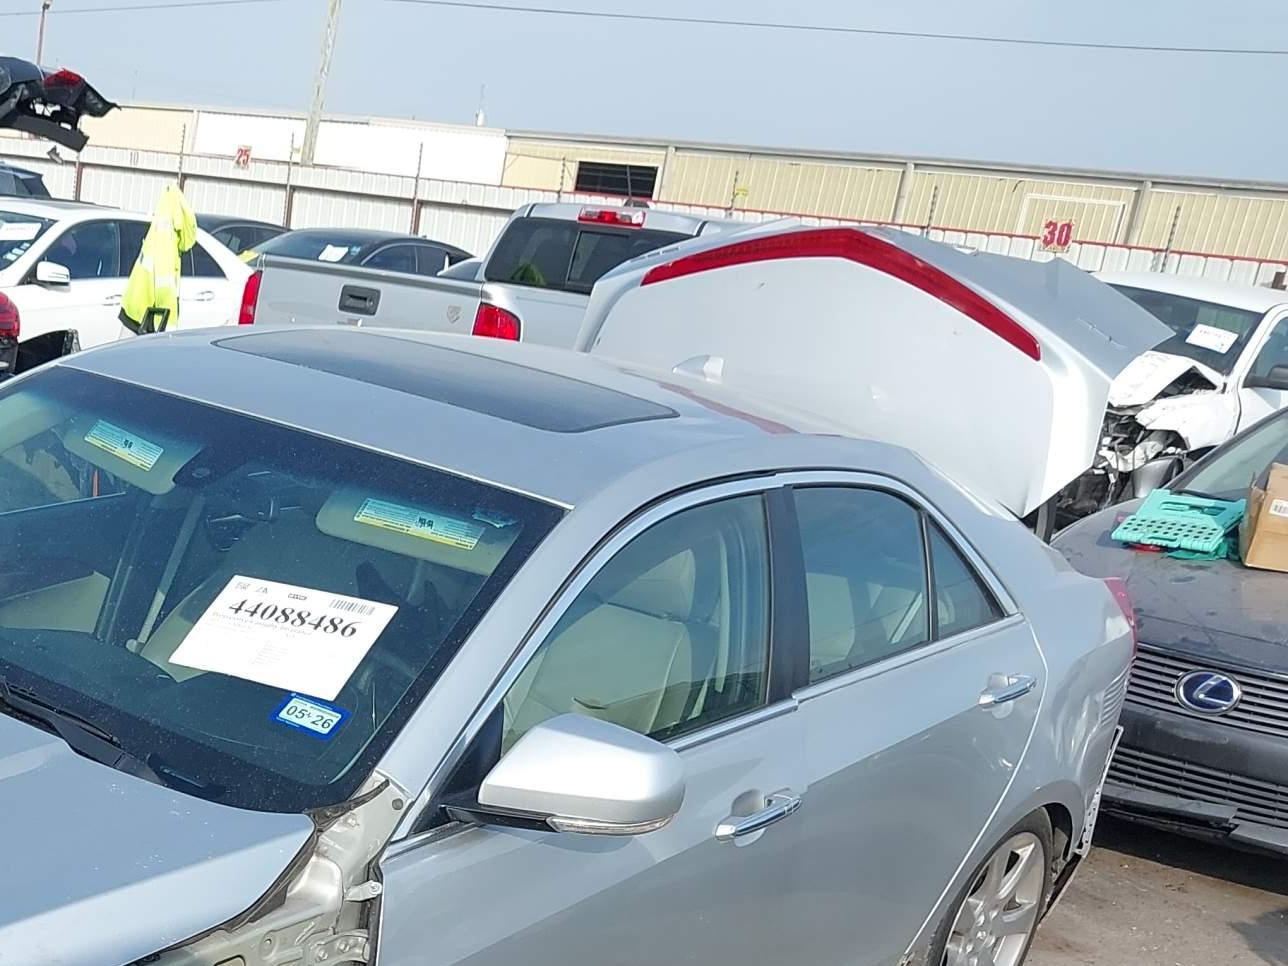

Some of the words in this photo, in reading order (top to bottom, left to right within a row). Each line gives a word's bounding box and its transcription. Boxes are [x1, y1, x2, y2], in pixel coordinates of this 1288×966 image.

[235, 147, 250, 166] 25
[1042, 220, 1072, 248] 30
[228, 598, 362, 639] 44088486
